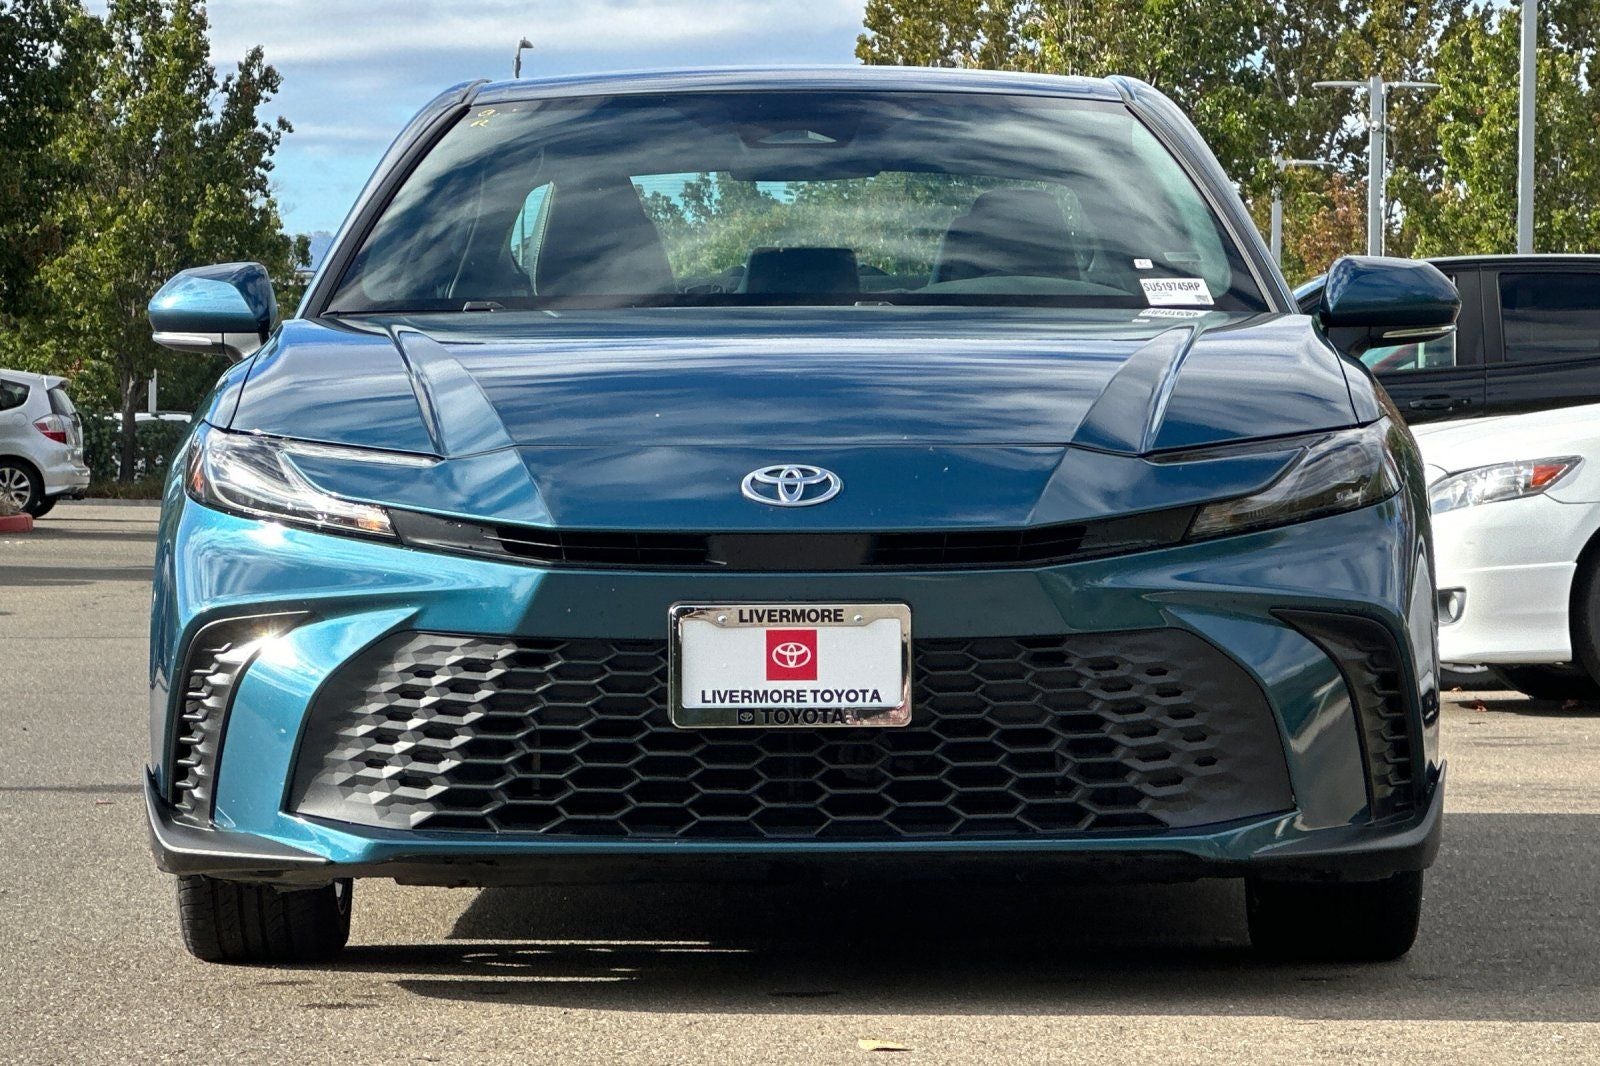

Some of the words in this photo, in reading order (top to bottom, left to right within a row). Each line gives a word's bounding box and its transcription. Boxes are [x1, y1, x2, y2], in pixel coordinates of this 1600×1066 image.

[738, 609, 844, 623] LIVERMORE
[701, 690, 807, 704] LIVERMORE
[810, 689, 882, 703] TOYOTA
[761, 708, 846, 724] TOYOTA
